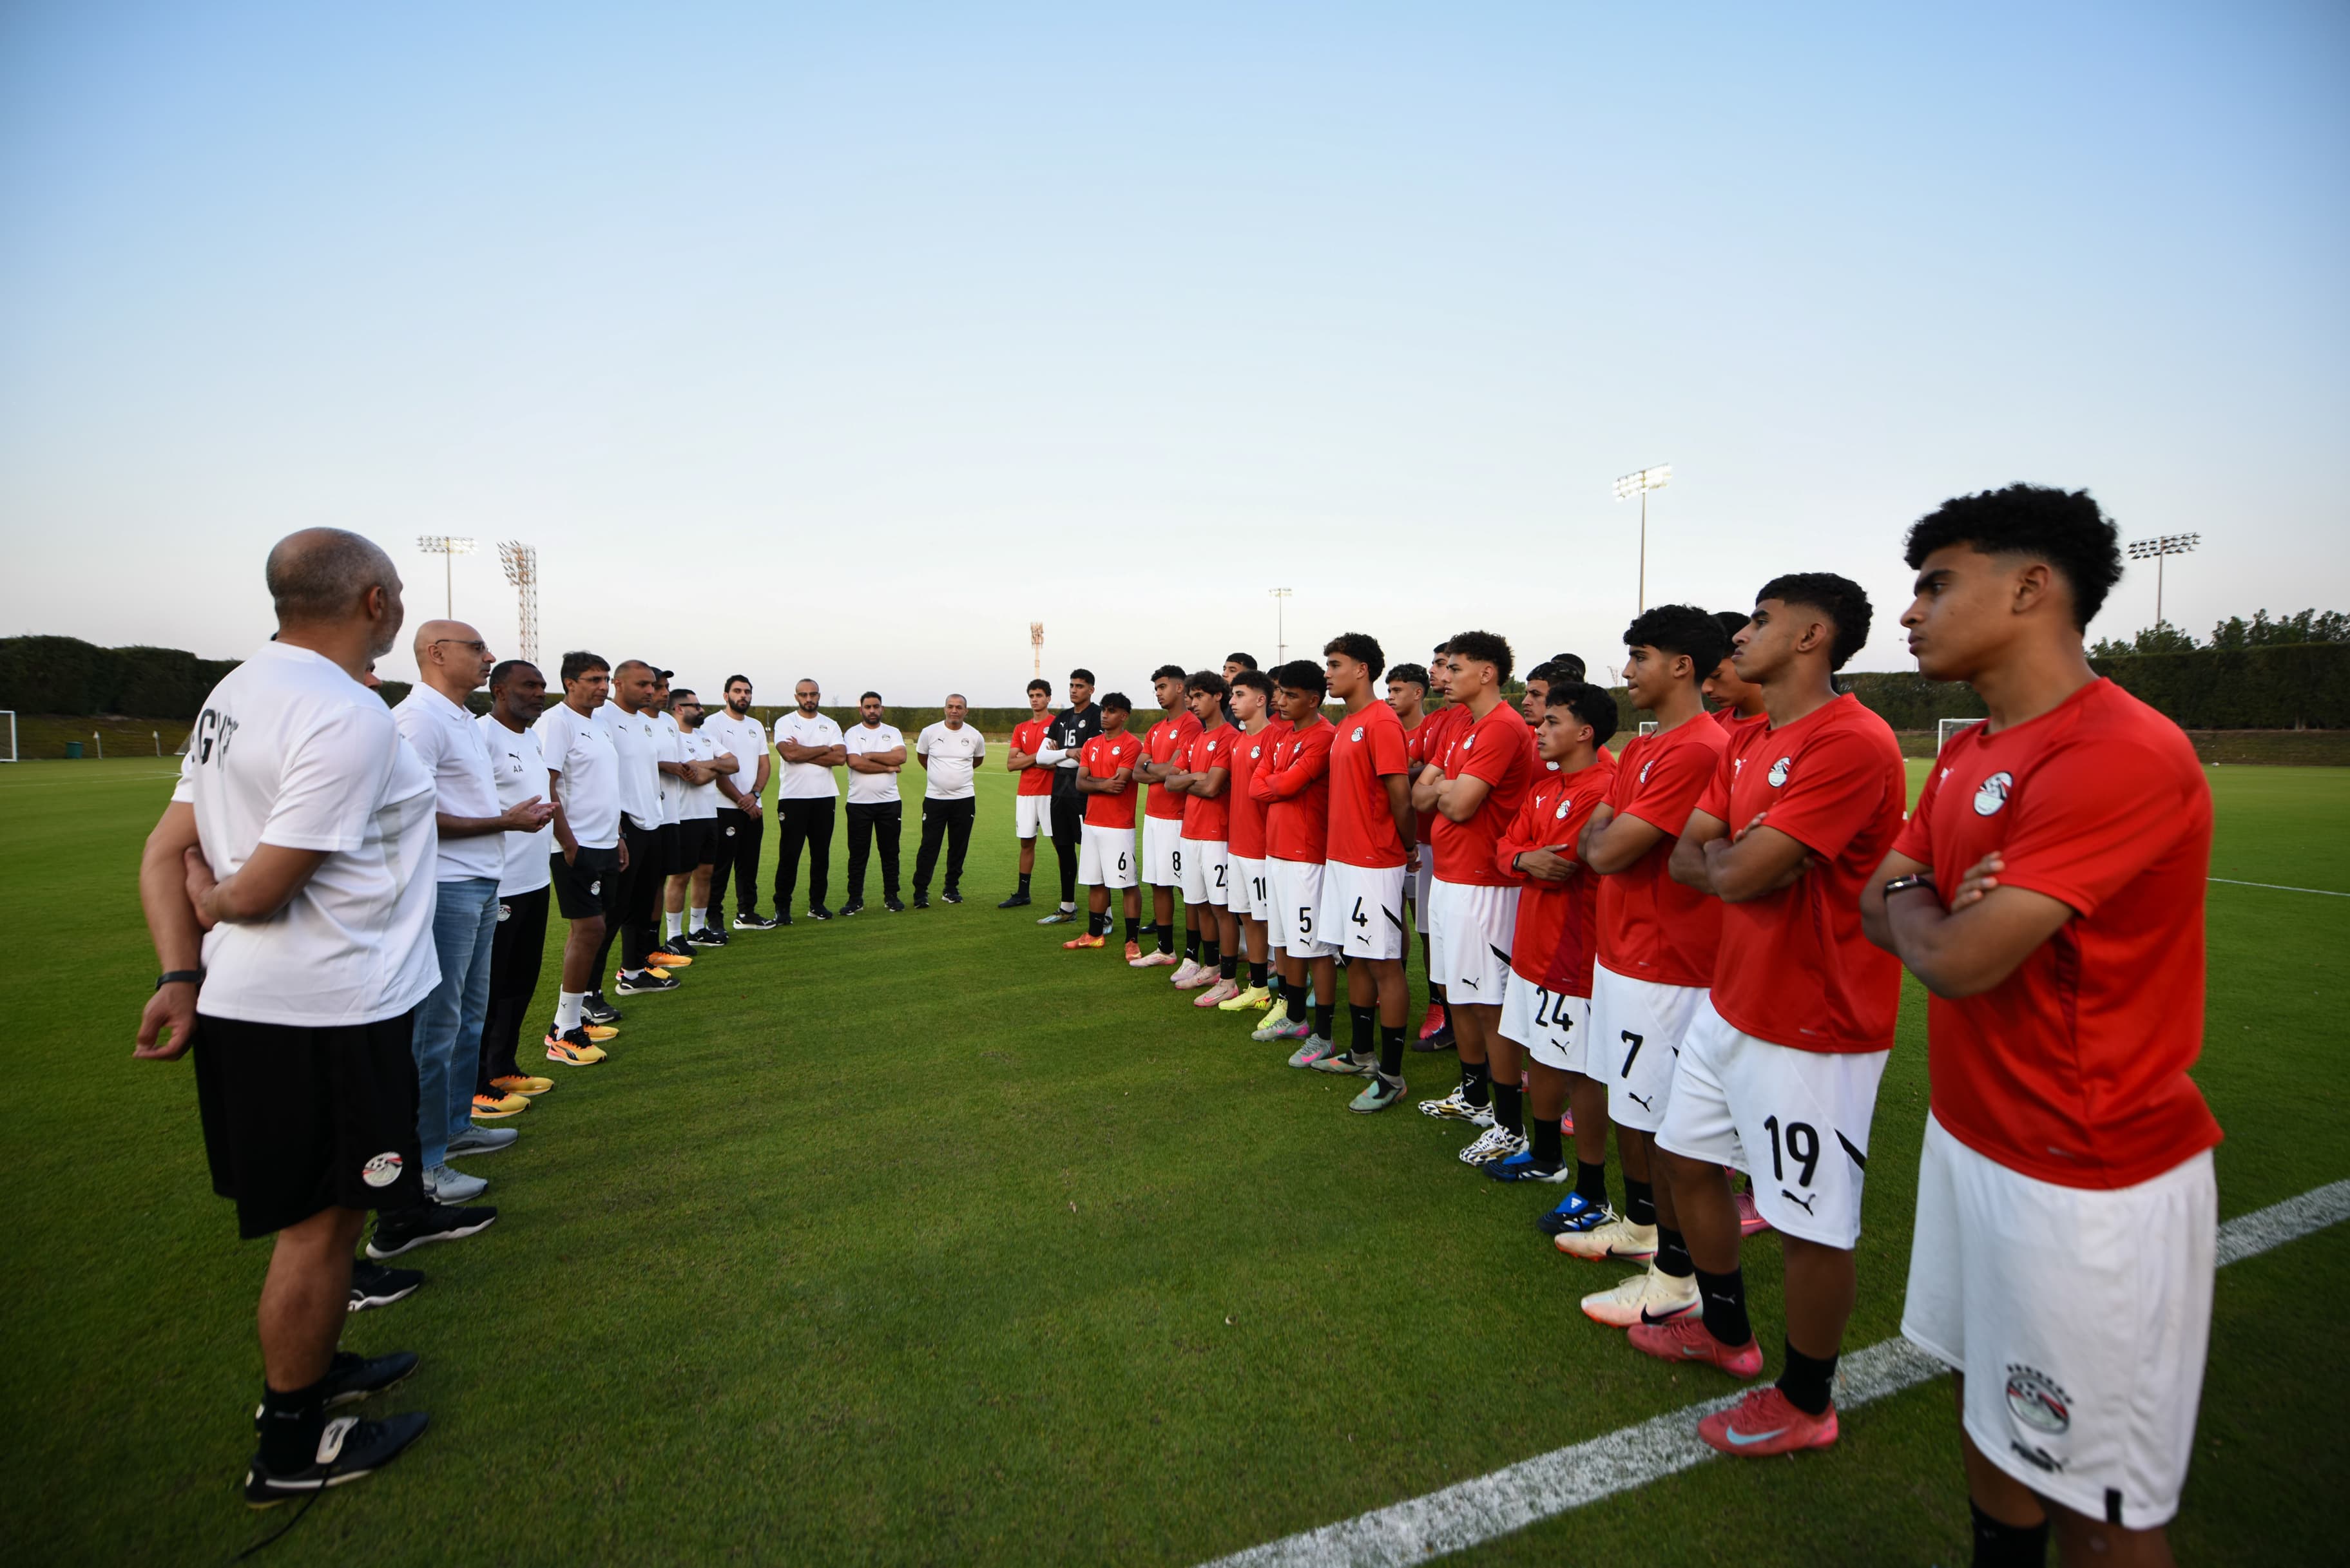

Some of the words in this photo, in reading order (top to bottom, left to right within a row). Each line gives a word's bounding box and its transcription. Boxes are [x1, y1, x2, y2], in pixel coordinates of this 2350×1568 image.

[1064, 729, 1076, 747] 16
[1091, 752, 1095, 762] 6
[1118, 851, 1126, 870] 6
[1172, 851, 1181, 872] 8
[1214, 864, 1228, 888] 2
[1300, 907, 1311, 933] 5
[1352, 896, 1368, 927] 4
[1535, 986, 1574, 1031] 24
[1621, 1029, 1643, 1078] 7
[1764, 1114, 1819, 1187] 19
